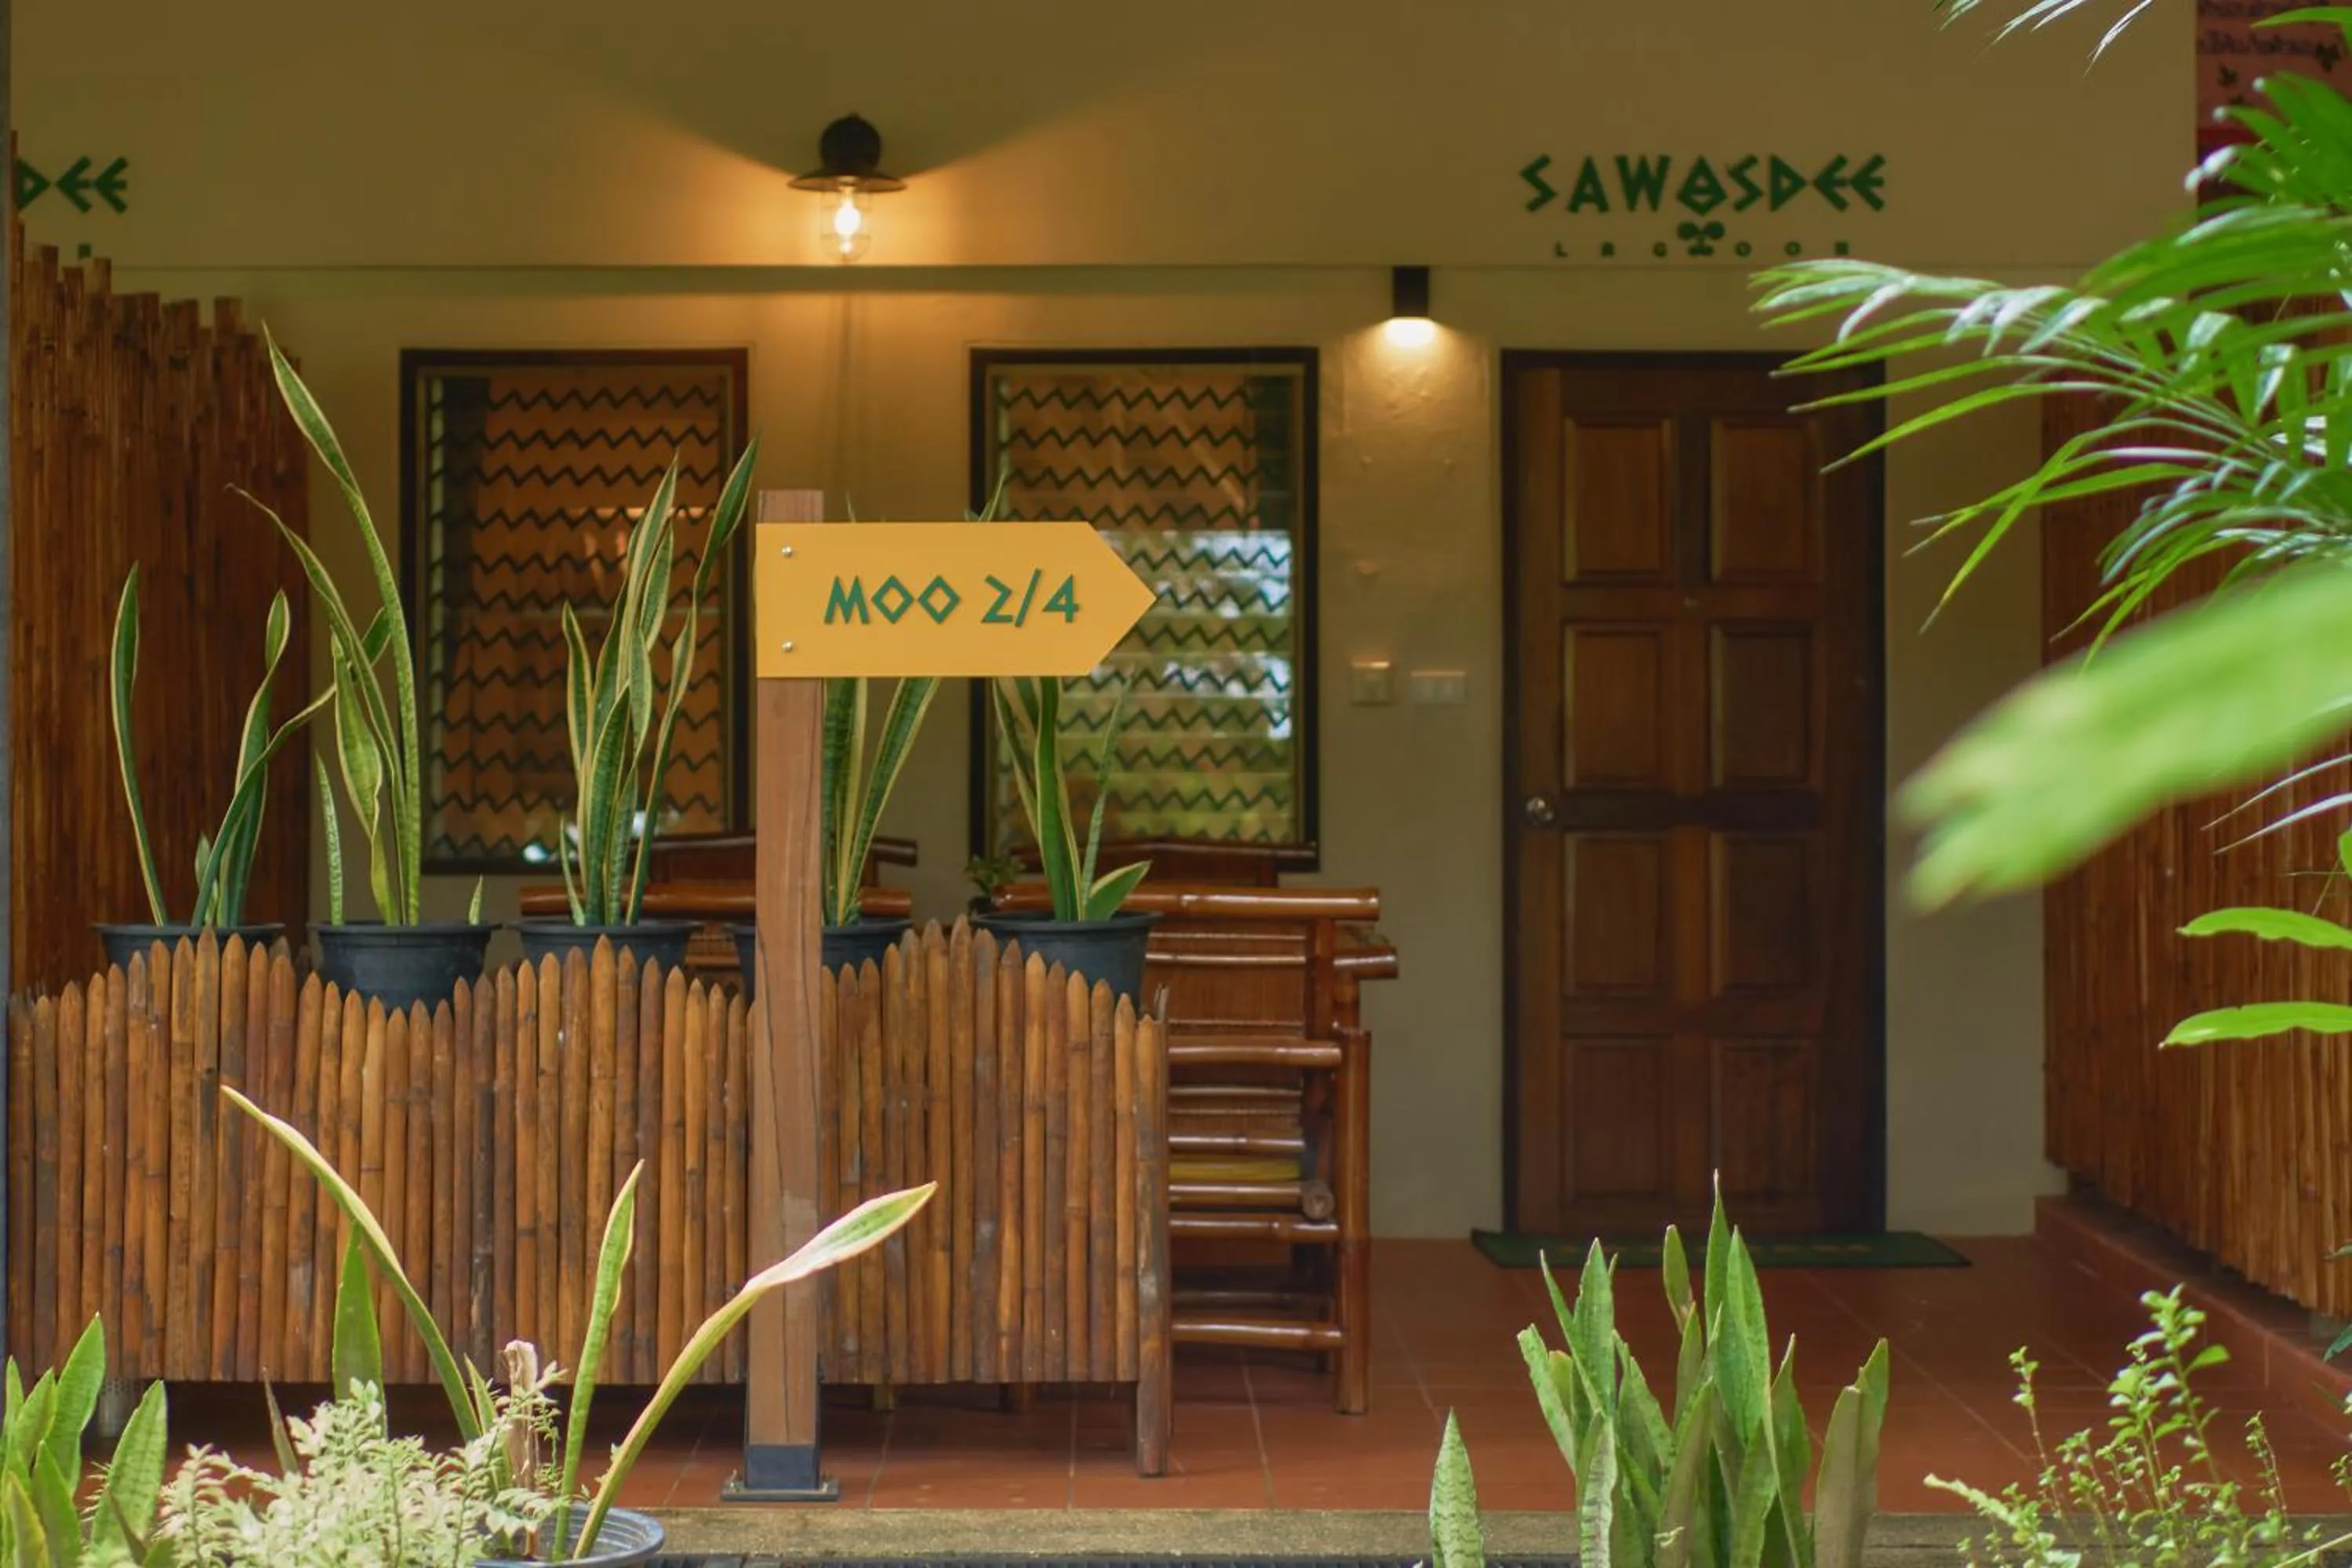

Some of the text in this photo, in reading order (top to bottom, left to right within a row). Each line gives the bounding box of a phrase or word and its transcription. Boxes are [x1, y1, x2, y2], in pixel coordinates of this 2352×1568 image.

[1519, 154, 1886, 216] SAWASDEE
[823, 568, 1080, 627] MOO 2/4
